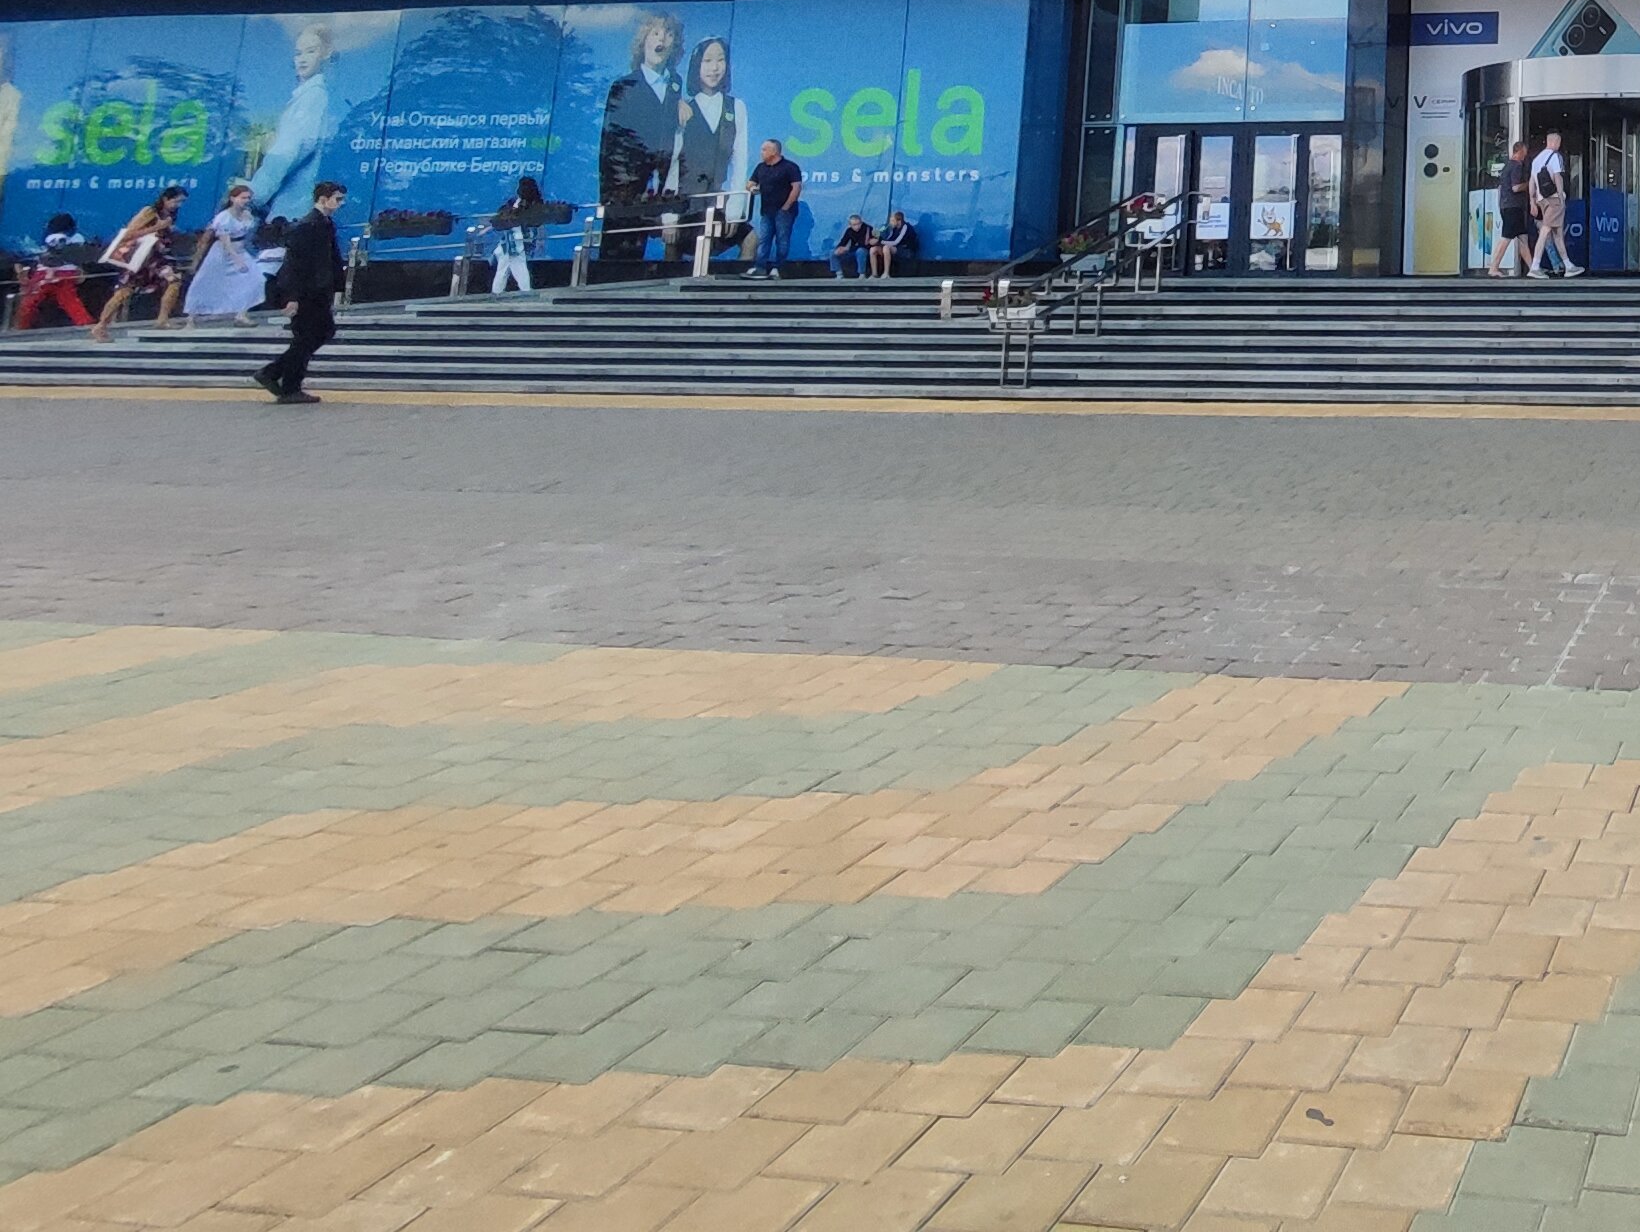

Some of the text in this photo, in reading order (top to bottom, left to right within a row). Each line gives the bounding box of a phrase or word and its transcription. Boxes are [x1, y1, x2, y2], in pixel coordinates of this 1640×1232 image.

[1426, 18, 1484, 36] vivo
[1217, 76, 1264, 104] INCATO
[35, 76, 209, 166] sela
[409, 111, 486, 128] Открылся
[490, 110, 551, 129] первый
[785, 68, 985, 157] sela
[350, 134, 459, 154] флагманский
[463, 137, 527, 150] магазин
[374, 157, 467, 177] Республике
[470, 157, 545, 176] Беларусь
[801, 170, 840, 183] oms
[873, 167, 981, 183] monsters
